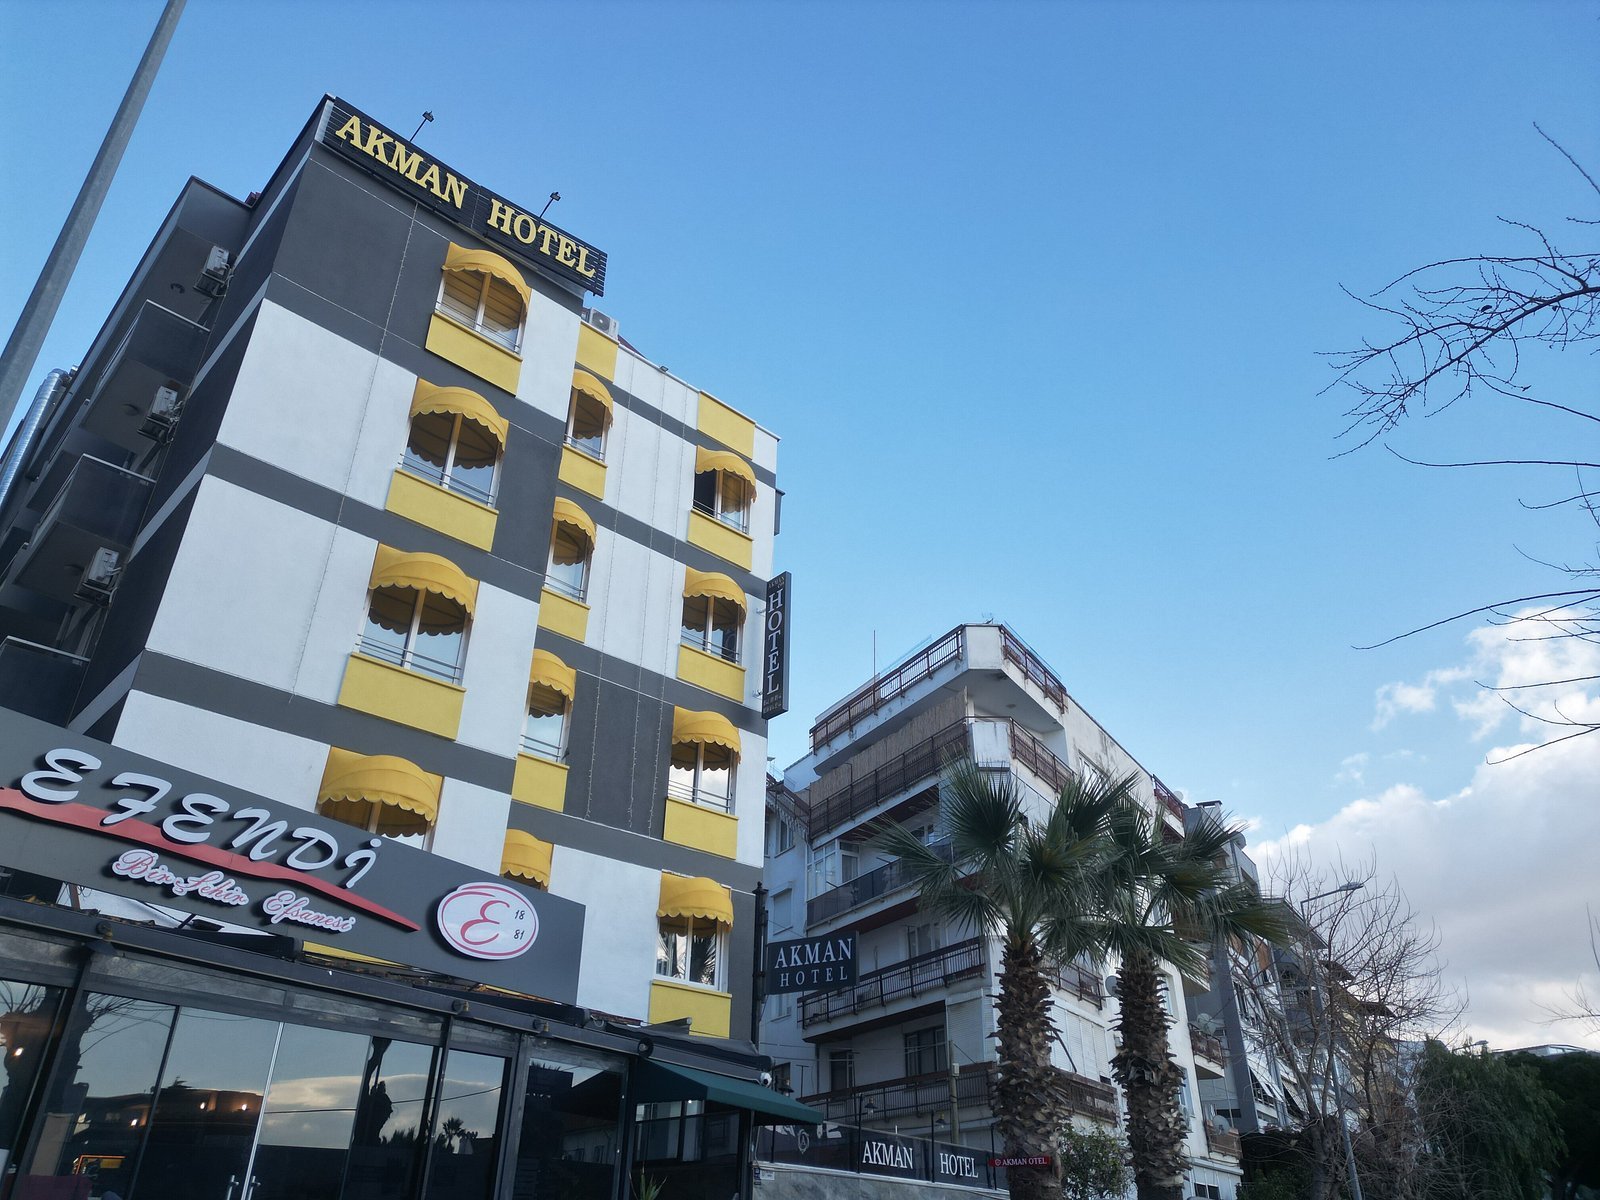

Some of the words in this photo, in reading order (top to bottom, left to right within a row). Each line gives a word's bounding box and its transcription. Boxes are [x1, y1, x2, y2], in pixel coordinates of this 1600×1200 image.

[335, 115, 468, 209] AKMAN
[487, 198, 596, 278] HOTEL
[767, 588, 783, 695] HOTEL
[112, 849, 175, 885] Bir
[263, 890, 356, 932] Efsanesi
[514, 909, 525, 920] 18
[513, 929, 525, 940] 81
[774, 938, 852, 969] AKMAN
[780, 966, 848, 987] HOTEL
[862, 1140, 913, 1169] AKMAN
[939, 1152, 979, 1178] HOTEL
[1002, 1158, 1027, 1166] AKMAN
[1028, 1157, 1047, 1165] OTEL
